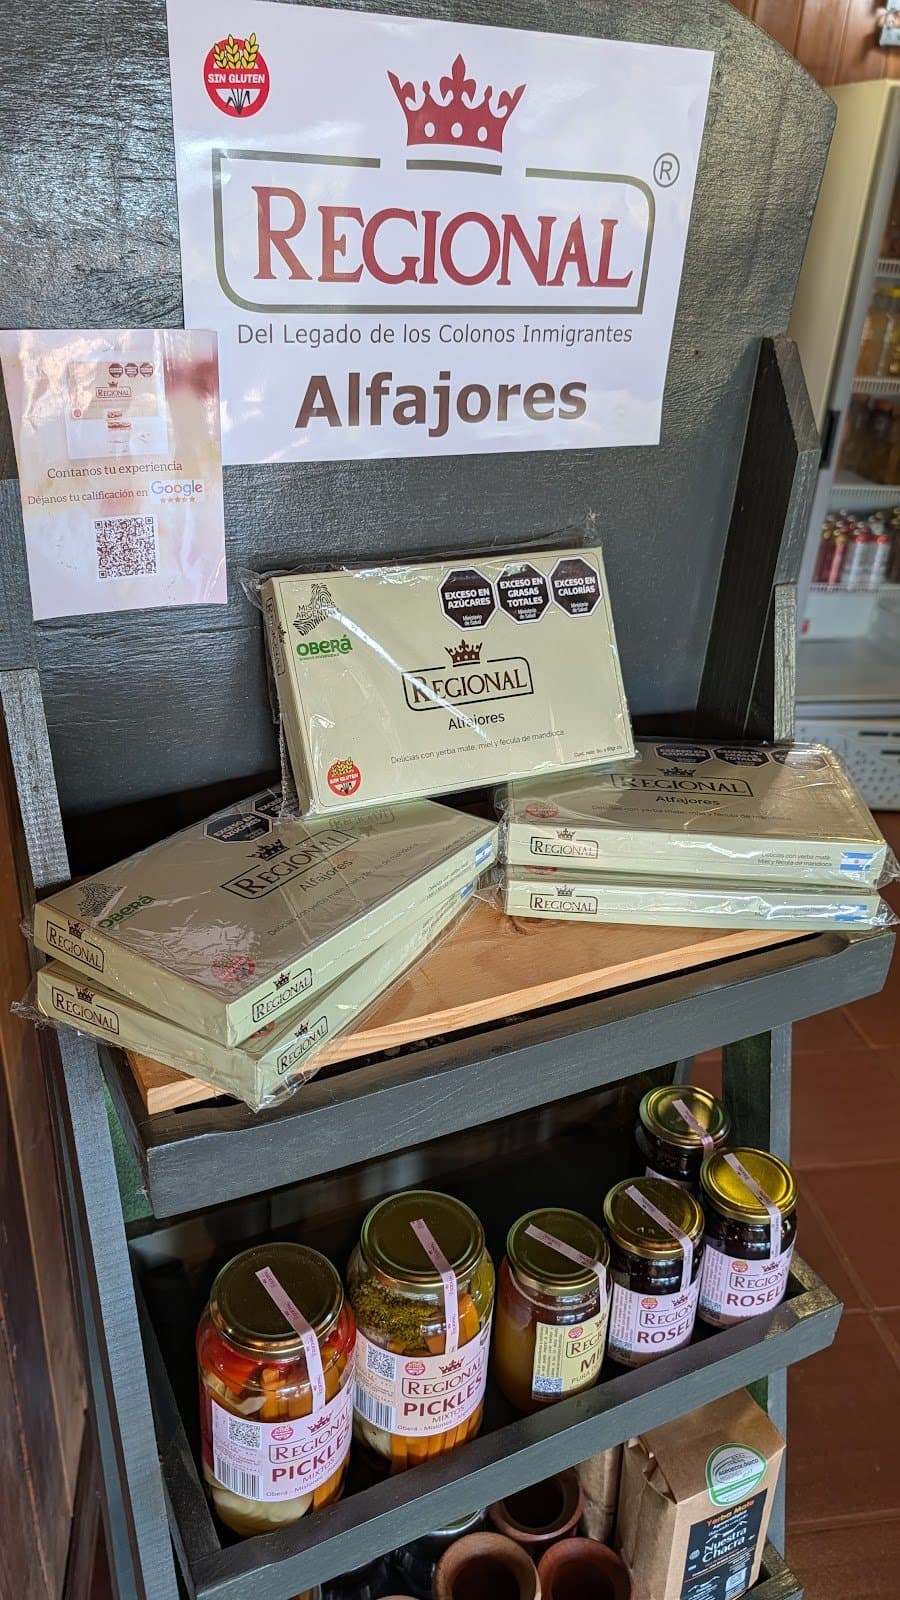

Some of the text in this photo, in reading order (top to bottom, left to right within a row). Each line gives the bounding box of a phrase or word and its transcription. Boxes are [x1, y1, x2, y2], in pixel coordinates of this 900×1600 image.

[207, 74, 265, 84] SIN GLUTEN
[252, 186, 633, 289] REGIONAL
[237, 323, 633, 349] Del Legado de los Colonos Inmigrantes
[295, 370, 588, 438] Alfajores
[47, 461, 183, 479] Contanos tu experiencia
[27, 487, 149, 506] Déjanos tu calificación en
[151, 480, 203, 496] Google
[500, 577, 544, 589] EXCESO EN
[554, 576, 596, 588] EXCESO EN
[558, 584, 596, 597] CALORÍAS
[445, 588, 490, 600] EXCESO EN
[507, 587, 540, 598] GRASAS
[447, 596, 491, 609] AZÚCARES
[507, 596, 544, 608] TOTALES
[413, 668, 527, 703] REGIONAL
[420, 750, 435, 760] con
[435, 747, 456, 761] yerba
[621, 777, 746, 793] REGIONAL
[656, 795, 720, 806] Alfajores
[535, 841, 595, 856] REGIONAL
[234, 836, 349, 894] REGIONAL
[300, 859, 353, 892] Alfajores
[534, 897, 595, 912] REGIONAL
[49, 927, 102, 969] REGIONAL
[256, 976, 311, 1019] REGIONAL
[56, 993, 117, 1034] REGIONAL
[280, 1026, 327, 1072] REGIONAL
[404, 1372, 481, 1417] PICKLES
[432, 1406, 464, 1423] MIXTOS
[303, 1456, 335, 1483] MIXTOS
[707, 1512, 732, 1527] Yerba
[733, 1500, 755, 1514] Mate
[702, 1536, 745, 1563] Chacra
[704, 1527, 747, 1554] Nuestra
